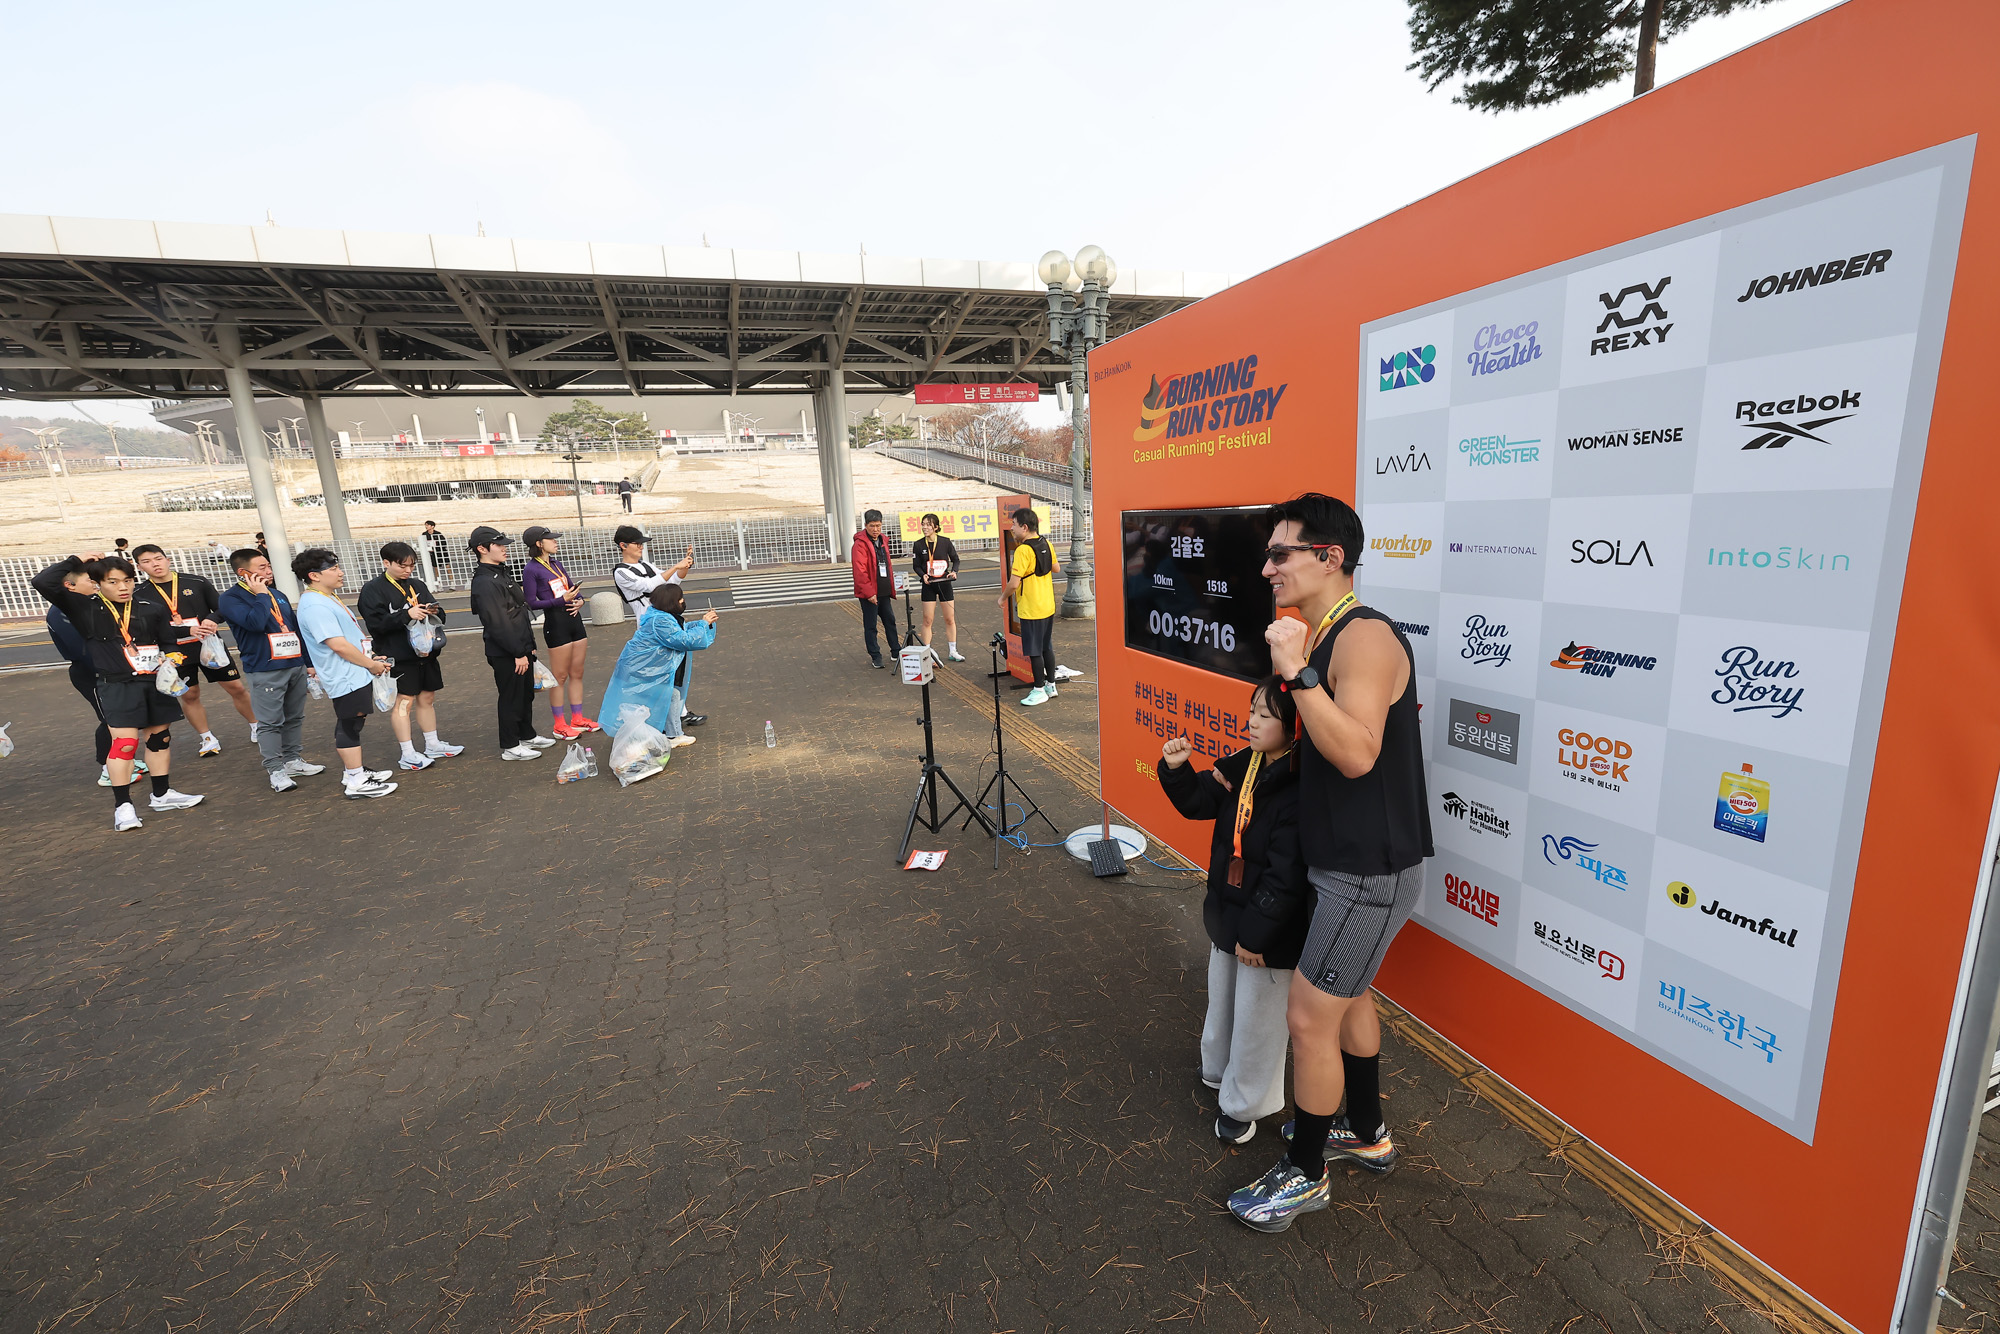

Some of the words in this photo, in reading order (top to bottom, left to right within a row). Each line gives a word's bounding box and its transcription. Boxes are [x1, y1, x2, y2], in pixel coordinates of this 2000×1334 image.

[1737, 249, 1893, 303] JOHNBER
[1473, 320, 1539, 351] Choco
[1590, 322, 1674, 356] REXY
[1380, 344, 1436, 375] MONO
[1467, 336, 1542, 376] Health
[1165, 354, 1258, 409] BURNING
[1165, 404, 1203, 440] RUN
[1207, 383, 1288, 432] STORY
[1735, 389, 1862, 422] Reebok
[1133, 444, 1165, 464] Casual
[1167, 437, 1216, 460] Running
[1218, 427, 1271, 452] Festival
[1459, 434, 1507, 453] GREEN
[1567, 432, 1629, 451] WOMAN
[1632, 427, 1684, 446] SENSE
[1469, 446, 1540, 467] MONSTER
[906, 515, 956, 534] 화실
[961, 514, 992, 533] 입구
[1170, 535, 1206, 560] 김율호
[1450, 542, 1463, 553] KN
[1464, 545, 1537, 555] INTERNATIONAL
[1152, 573, 1174, 587] 10km
[1206, 579, 1228, 594] 1518
[1329, 600, 1347, 621] BURNING
[1149, 609, 1236, 652] 00:37:16
[1394, 621, 1430, 636] RNING
[1462, 614, 1509, 641] Run
[1461, 636, 1512, 668] Story
[1581, 648, 1657, 671] BURNING
[1714, 646, 1800, 681] Run
[1580, 661, 1616, 678] RUN
[1135, 681, 1178, 715] #버닝런
[1711, 674, 1804, 718] Story
[1453, 721, 1513, 755] 동원샘물
[1558, 728, 1633, 760] GOOD
[1135, 758, 1156, 781] 달리는
[1558, 747, 1630, 782] LUCK
[1562, 770, 1577, 780] 나의
[1596, 780, 1621, 793] 에너지
[1470, 806, 1510, 831] Habitat
[1729, 798, 1757, 808] 비타500
[1469, 817, 1479, 826] for
[1479, 821, 1509, 838] Humanity
[1469, 825, 1482, 834] Korea
[1575, 853, 1629, 891] 피죤
[1444, 872, 1500, 928] 일요신문
[1700, 900, 1798, 948] Jamful
[1533, 920, 1596, 963] 일요신문
[1540, 940, 1559, 952] REALTIME
[1559, 949, 1572, 959] NEWS
[1571, 955, 1585, 965] MEDIA
[1658, 979, 1783, 1064] 비즈한국
